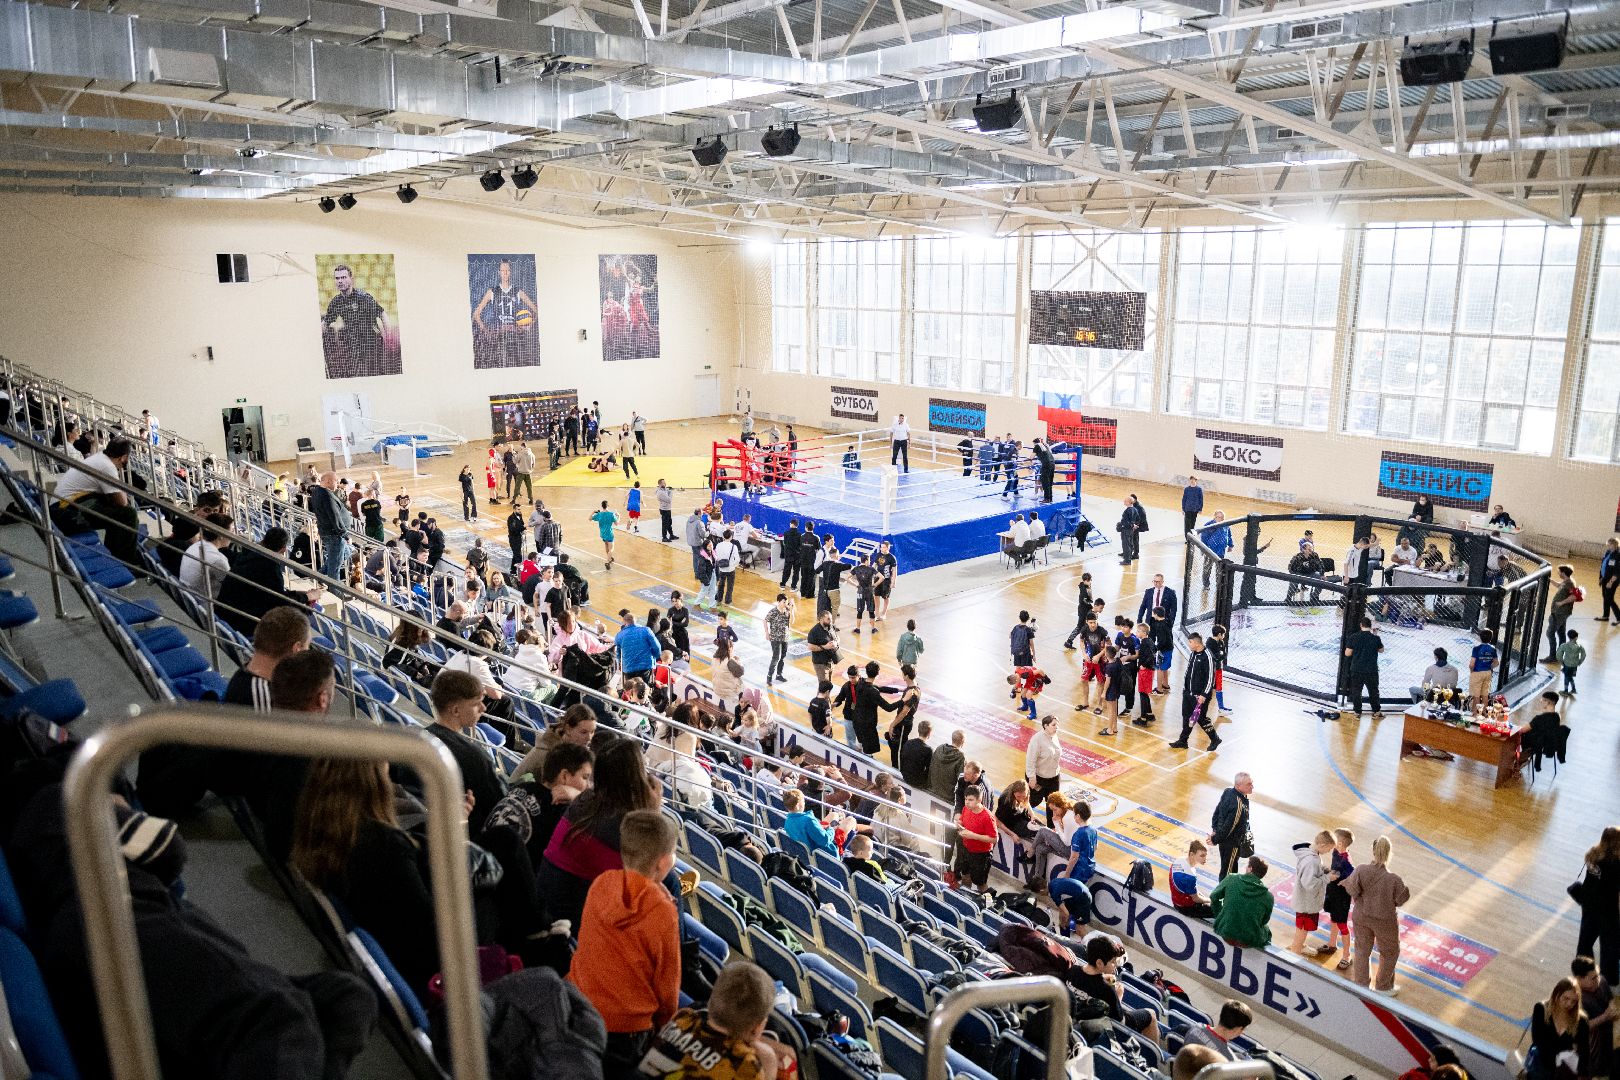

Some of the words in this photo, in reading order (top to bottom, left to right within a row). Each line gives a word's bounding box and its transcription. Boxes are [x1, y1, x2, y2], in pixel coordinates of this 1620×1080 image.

[833, 395, 874, 411] ФУТБОЛ
[931, 410, 983, 427] ВОЛЕЙБОЛ
[1212, 443, 1262, 465] БОКС
[1388, 465, 1482, 495] ТЕННИС
